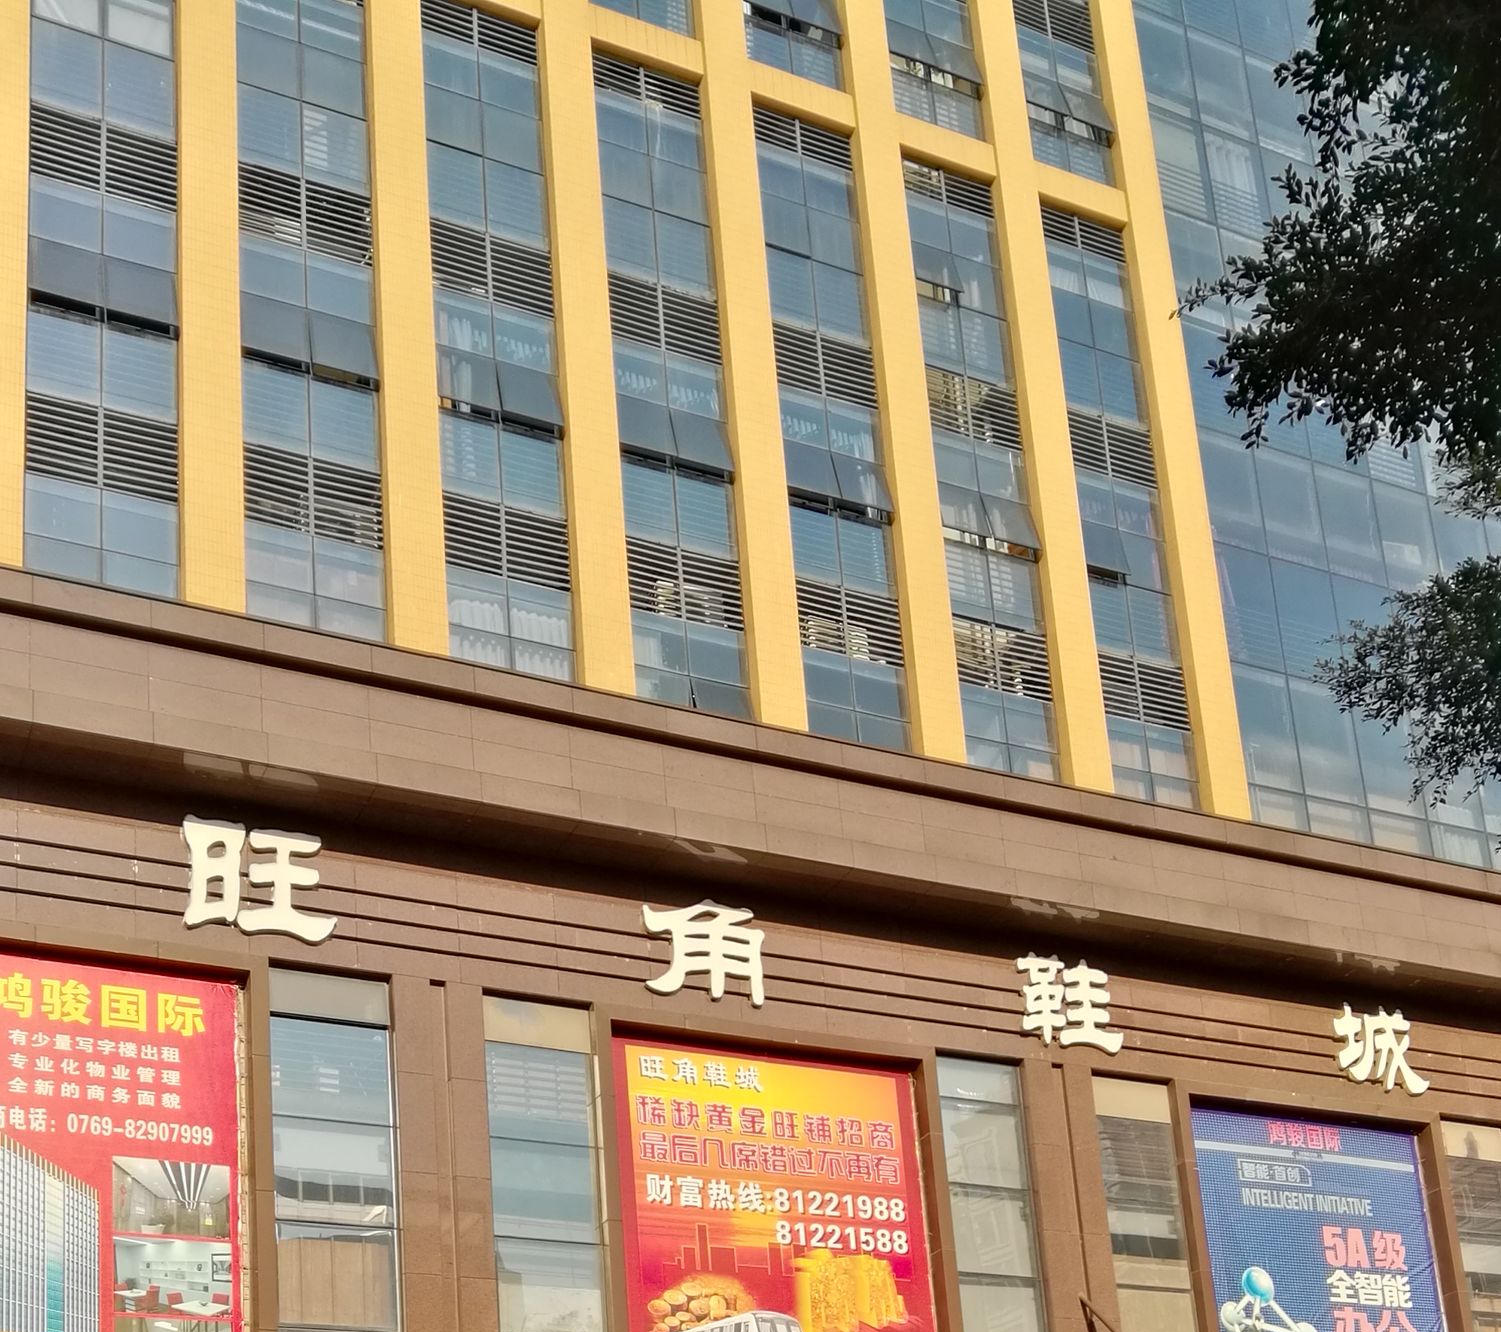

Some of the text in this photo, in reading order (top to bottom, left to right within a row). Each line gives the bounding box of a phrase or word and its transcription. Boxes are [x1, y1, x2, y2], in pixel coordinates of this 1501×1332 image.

[8, 1028, 181, 1063] 有少量写字楼出租
[8, 1053, 182, 1086] 专业化物业管理
[637, 1055, 764, 1093] 旺角鞋城
[8, 1078, 182, 1110] 全新的商务面貌
[635, 1095, 897, 1151] 稀缺黄金旺铺招商
[1267, 1120, 1342, 1152] 鸿骏国际
[639, 1131, 901, 1185] 最后几席错过不再有
[1242, 1188, 1373, 1217] INTELLIGENT INITIATIVE
[775, 1219, 910, 1255] 81221588
[1321, 1226, 1408, 1272] 5A级
[1326, 1269, 1412, 1308] 全智能
